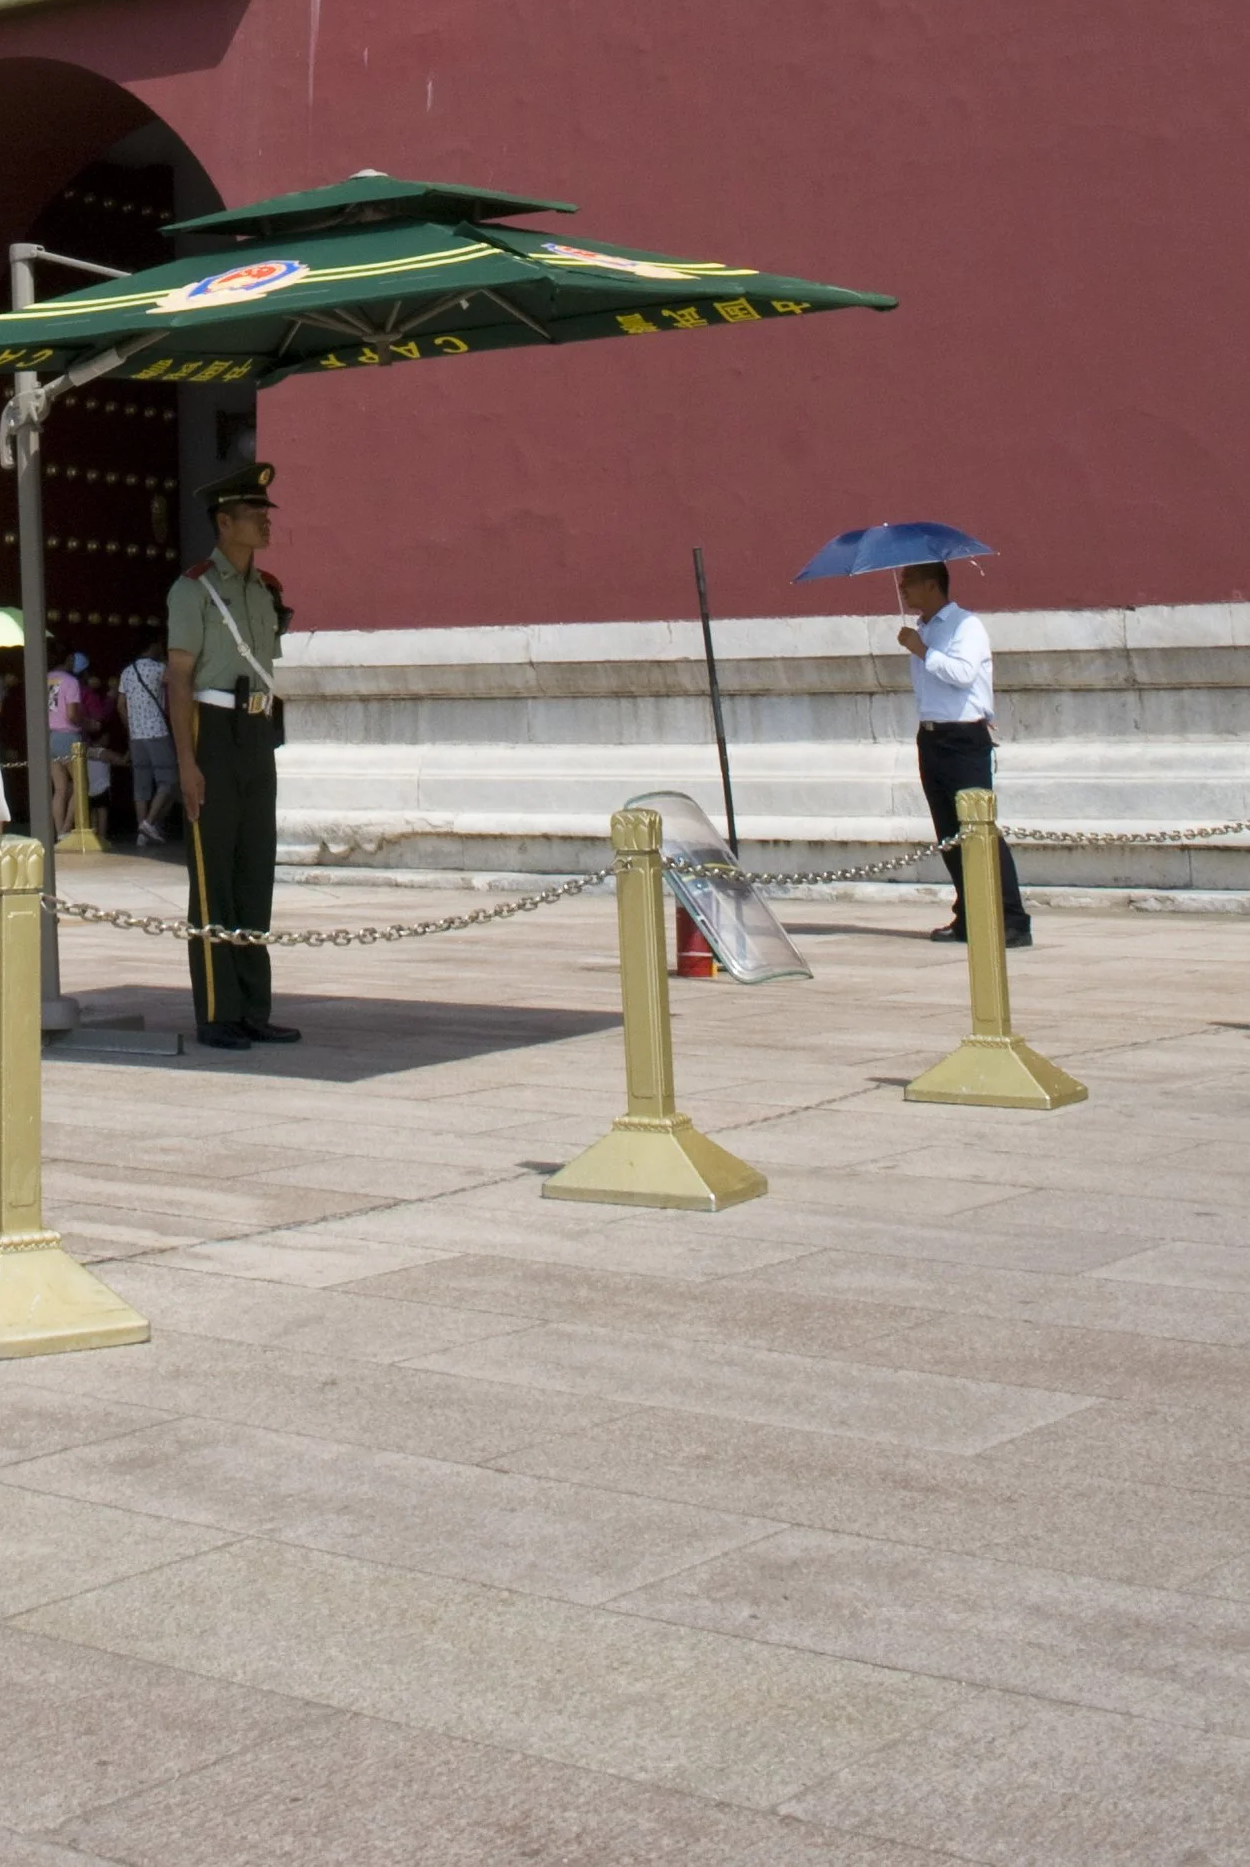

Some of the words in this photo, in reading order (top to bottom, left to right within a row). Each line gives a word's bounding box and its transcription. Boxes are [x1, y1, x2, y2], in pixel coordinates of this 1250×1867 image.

[615, 297, 811, 334] 中国武警
[319, 335, 469, 368] CAPF
